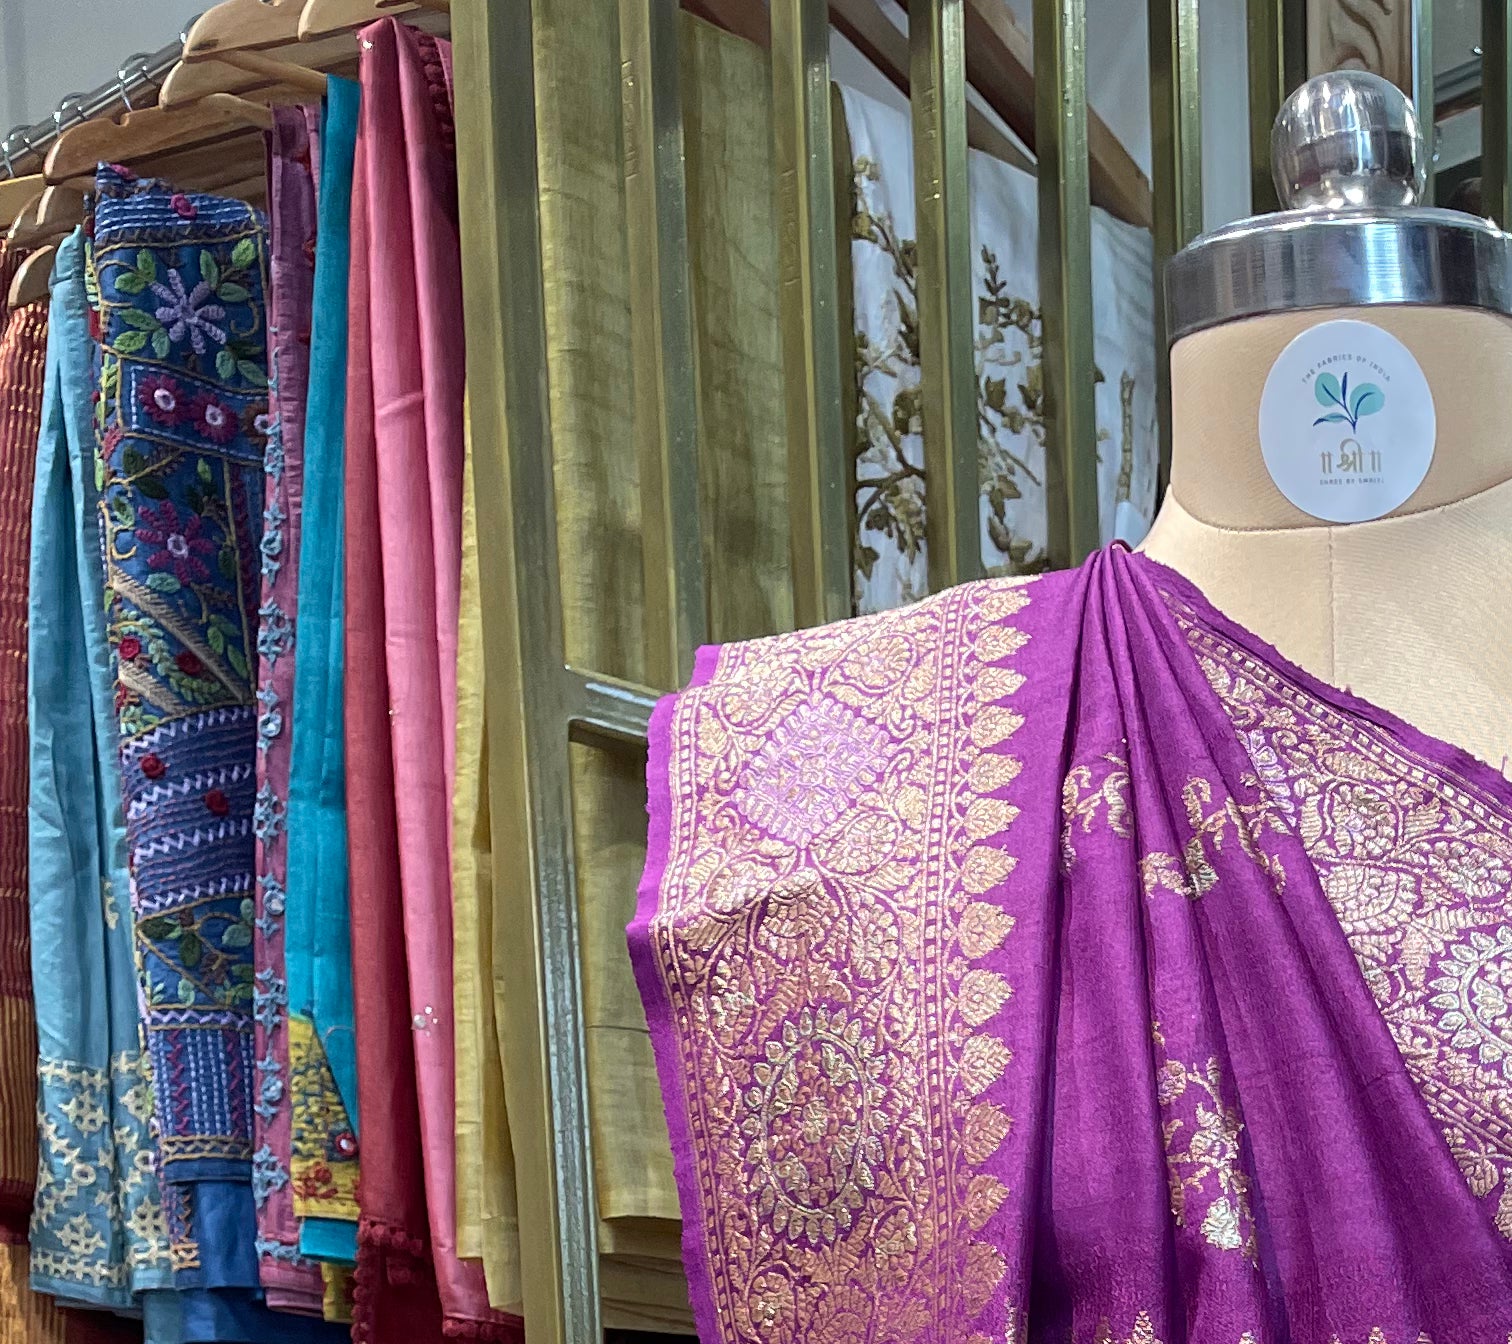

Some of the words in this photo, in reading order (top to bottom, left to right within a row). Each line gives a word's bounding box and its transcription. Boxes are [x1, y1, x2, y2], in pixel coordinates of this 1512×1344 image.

[1302, 368, 1316, 383] THE
[1317, 354, 1352, 369] FABRICS
[1356, 355, 1367, 363] OF
[1369, 361, 1391, 382] INDIA
